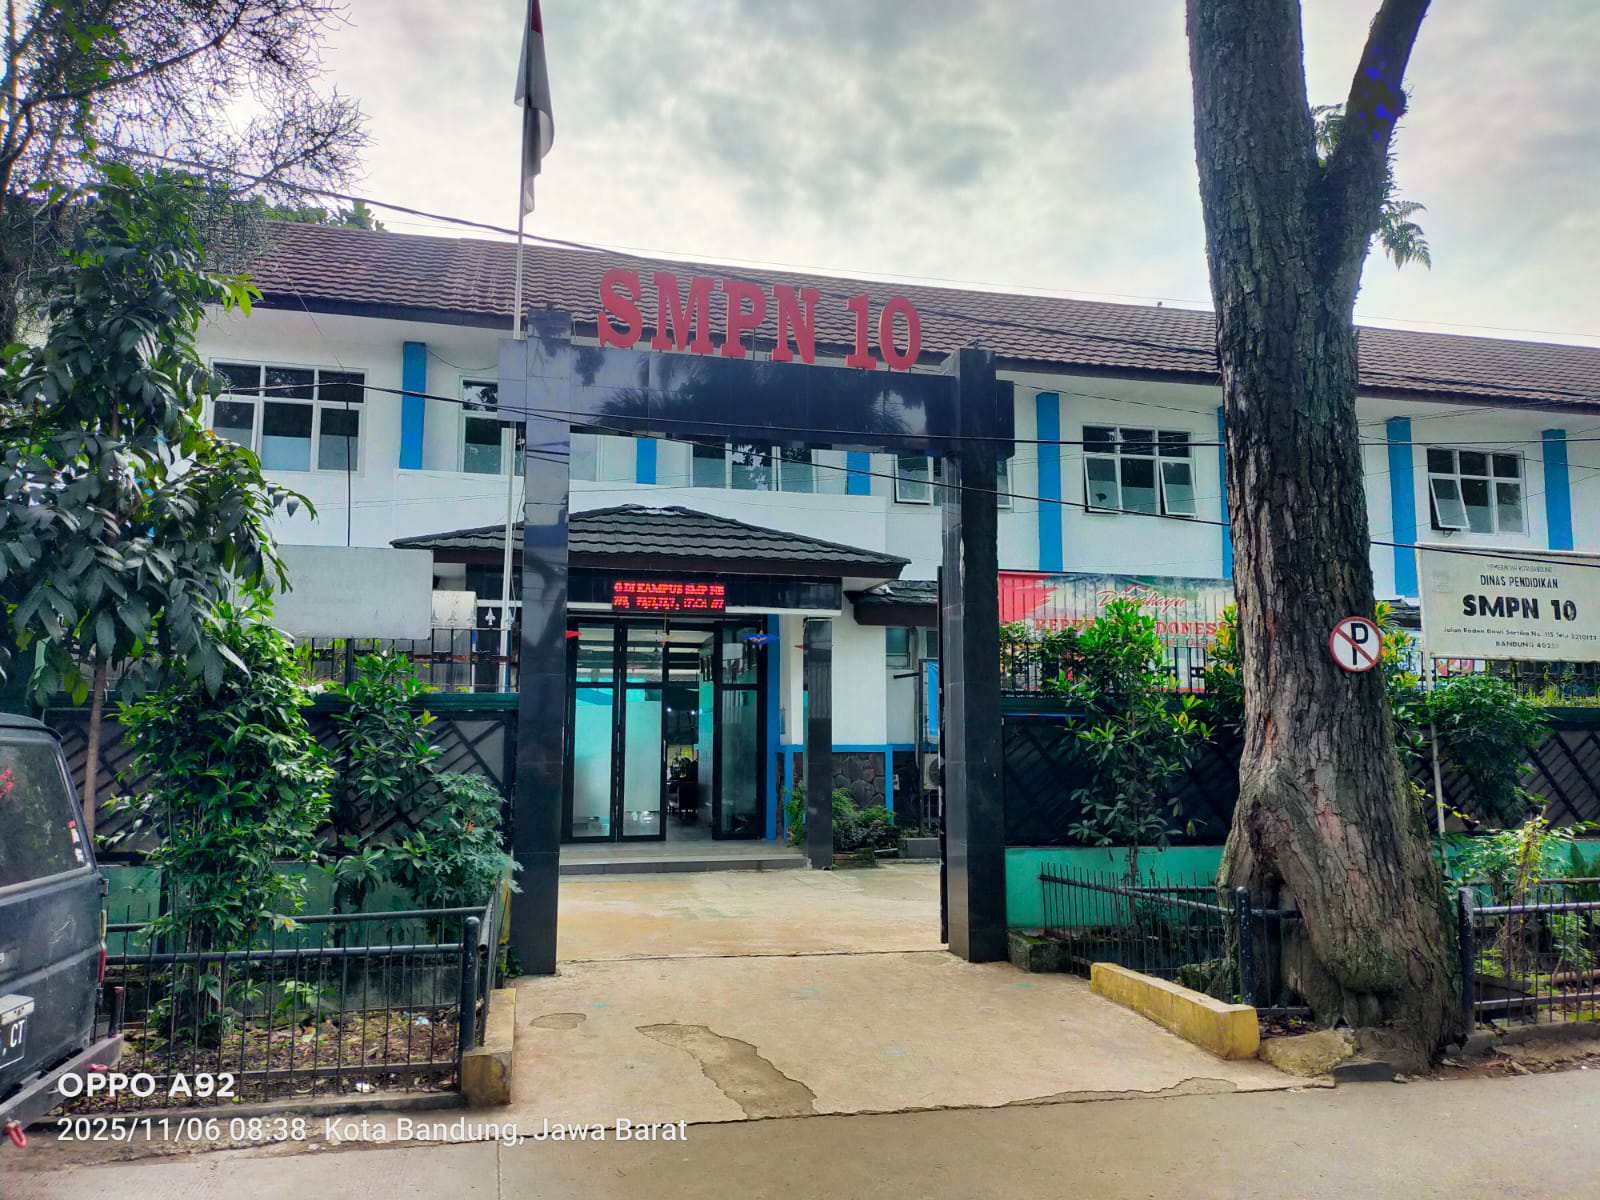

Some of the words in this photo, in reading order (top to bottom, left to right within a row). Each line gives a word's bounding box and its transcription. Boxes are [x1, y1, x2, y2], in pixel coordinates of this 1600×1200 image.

[597, 268, 820, 364] SMPN
[846, 293, 922, 371] 10
[1480, 574, 1507, 587] DINAS
[1509, 576, 1559, 589] PENDIDIKAN
[1096, 590, 1187, 614] Drgahayu
[1463, 594, 1540, 619] SMPN
[1551, 599, 1577, 621] 10
[1035, 618, 1115, 632] REPUB
[1140, 620, 1232, 635] DONES
[1443, 625, 1461, 633] Jalan
[1350, 622, 1369, 666] P
